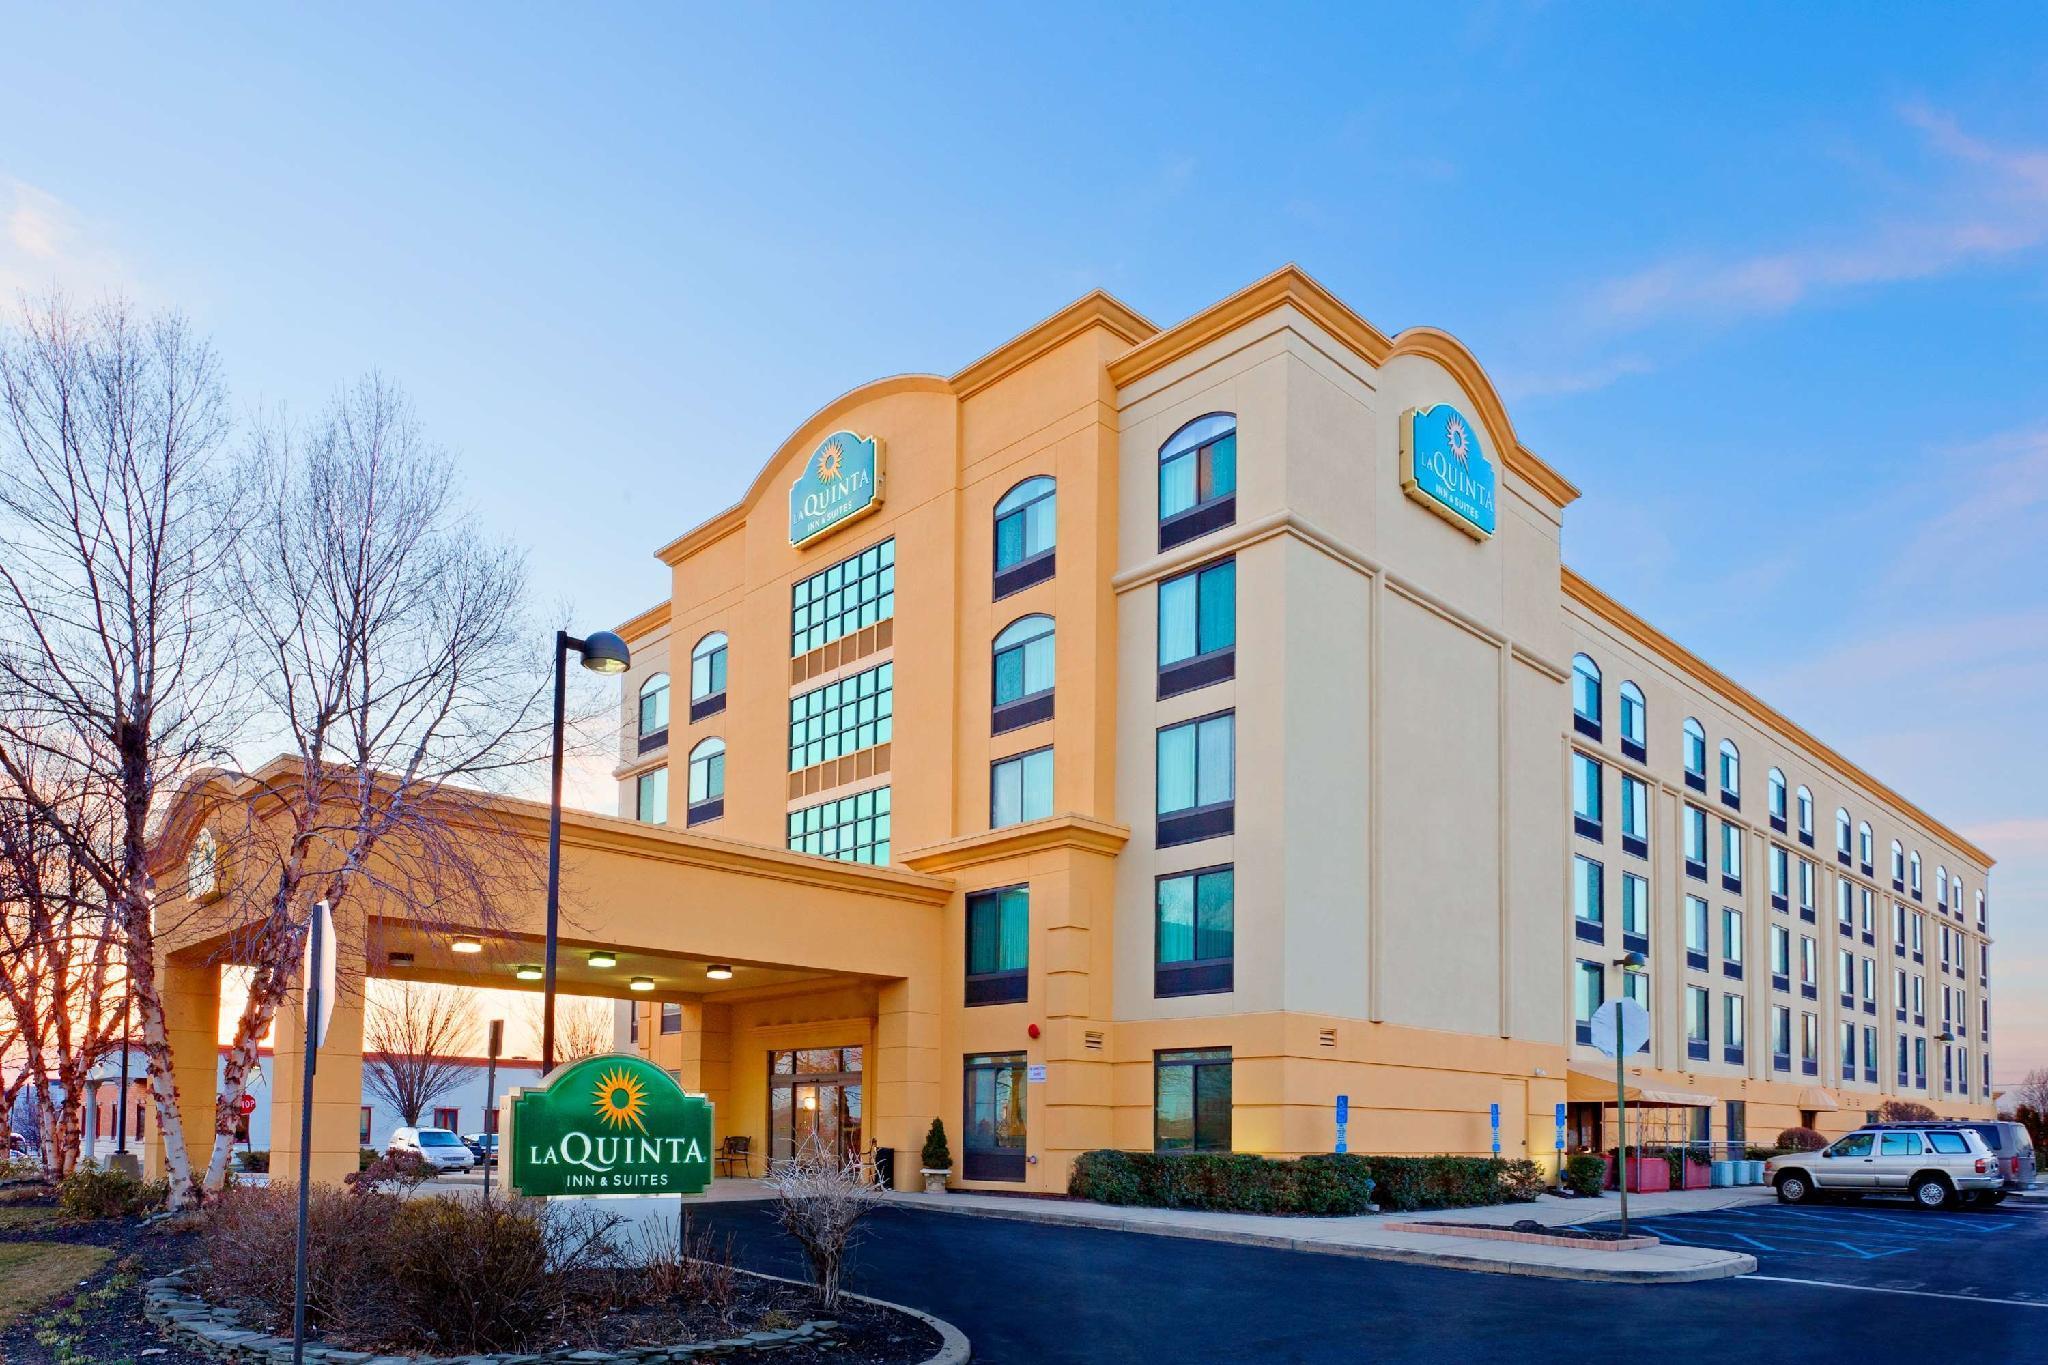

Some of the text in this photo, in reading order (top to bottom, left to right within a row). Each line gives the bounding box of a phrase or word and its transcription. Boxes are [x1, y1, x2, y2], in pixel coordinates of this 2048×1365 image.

[804, 468, 869, 516] QUINTA
[1421, 451, 1493, 512] LA QUINTA
[530, 1131, 705, 1172] LA QUINTA
[566, 1174, 669, 1187] INN & SUITES
